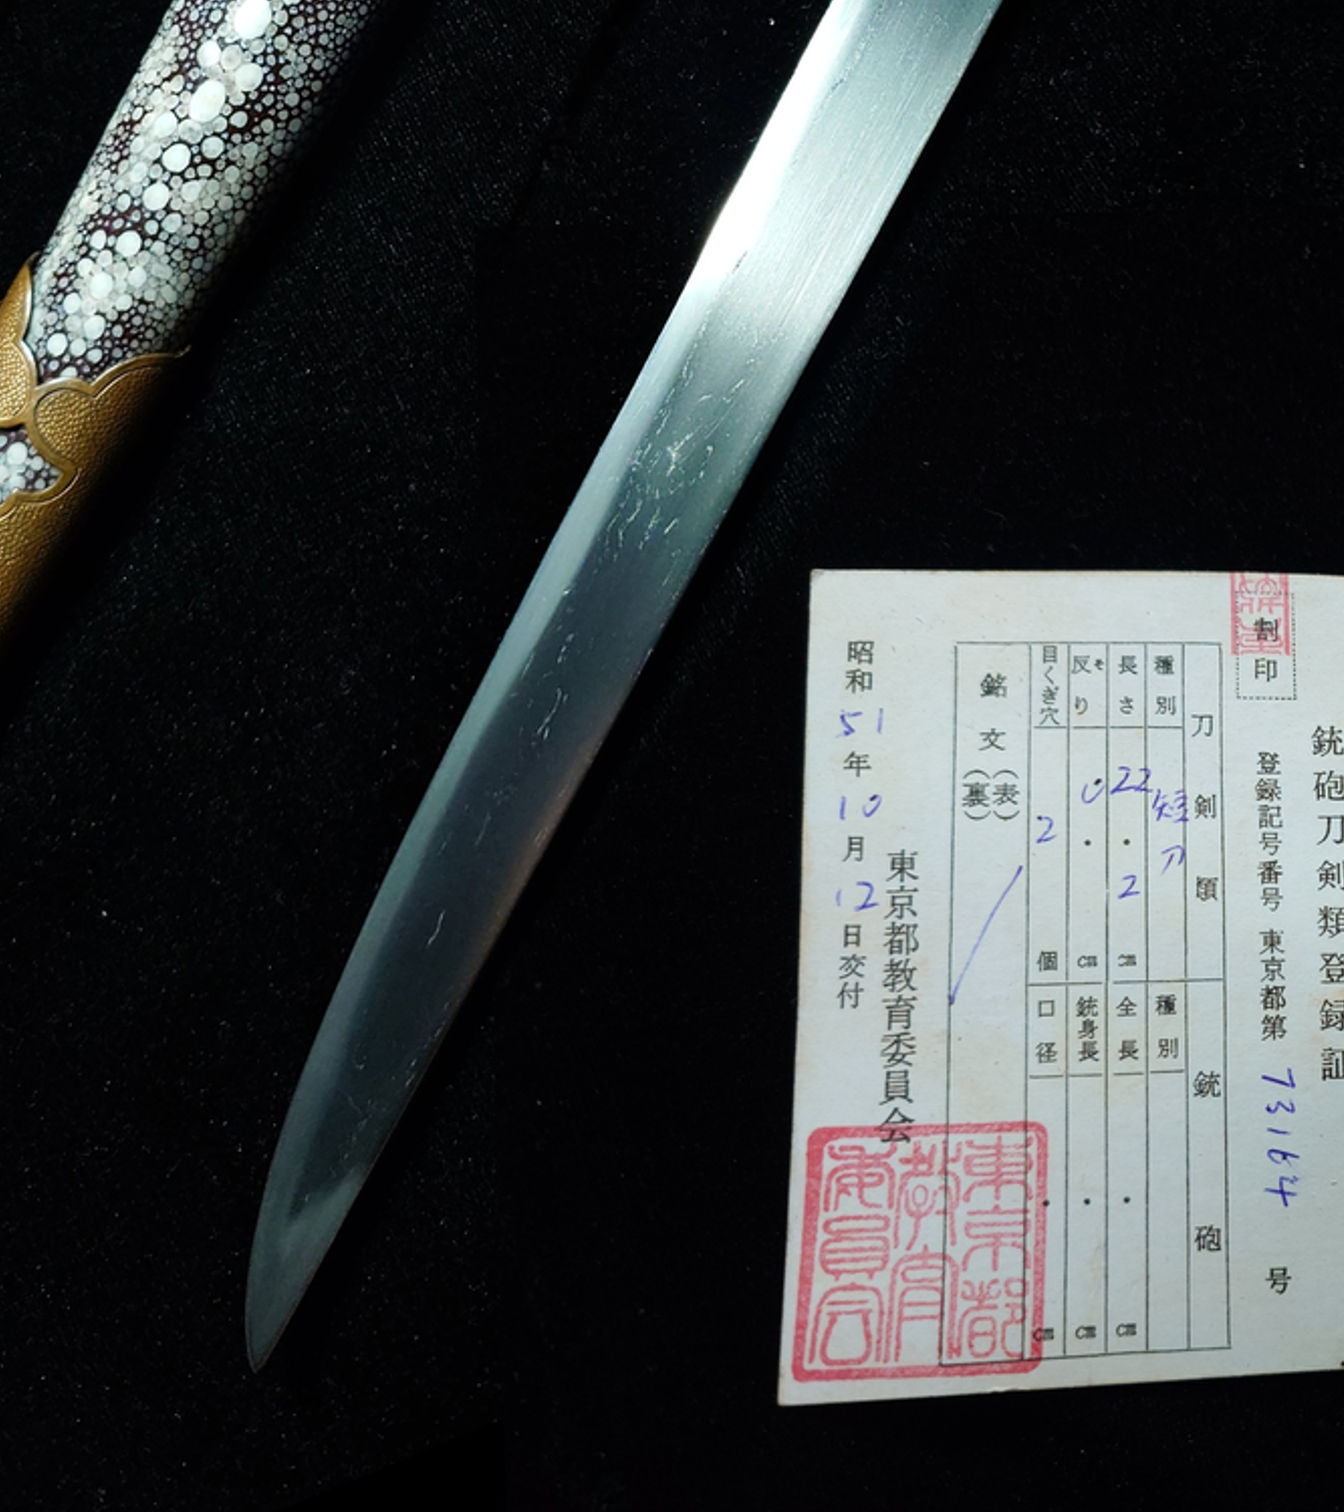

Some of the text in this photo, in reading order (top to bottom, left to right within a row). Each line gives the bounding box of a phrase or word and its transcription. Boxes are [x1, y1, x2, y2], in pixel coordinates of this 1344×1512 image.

[845, 640, 875, 694] 昭和
[1254, 617, 1280, 683] 割印
[978, 673, 1007, 751] 銘文
[1118, 656, 1138, 715] 長さ
[1153, 655, 1177, 716] 種別
[843, 750, 872, 778] 年
[838, 793, 883, 820] 10
[1035, 644, 1061, 972] 目くぎ穴 2 個
[1256, 751, 1284, 912] 登録記号番号
[842, 835, 865, 862] 月
[835, 881, 879, 912] 12
[836, 923, 867, 1009] 日交付
[878, 848, 920, 1144] 東京都教育委員会
[1259, 929, 1288, 1042] 東京都第
[1035, 999, 1058, 1064] 口径
[1075, 996, 1100, 1062] 銃身長
[1115, 996, 1140, 1061] 全長
[1155, 994, 1180, 1059] 種別
[1265, 1266, 1293, 1295] 号
